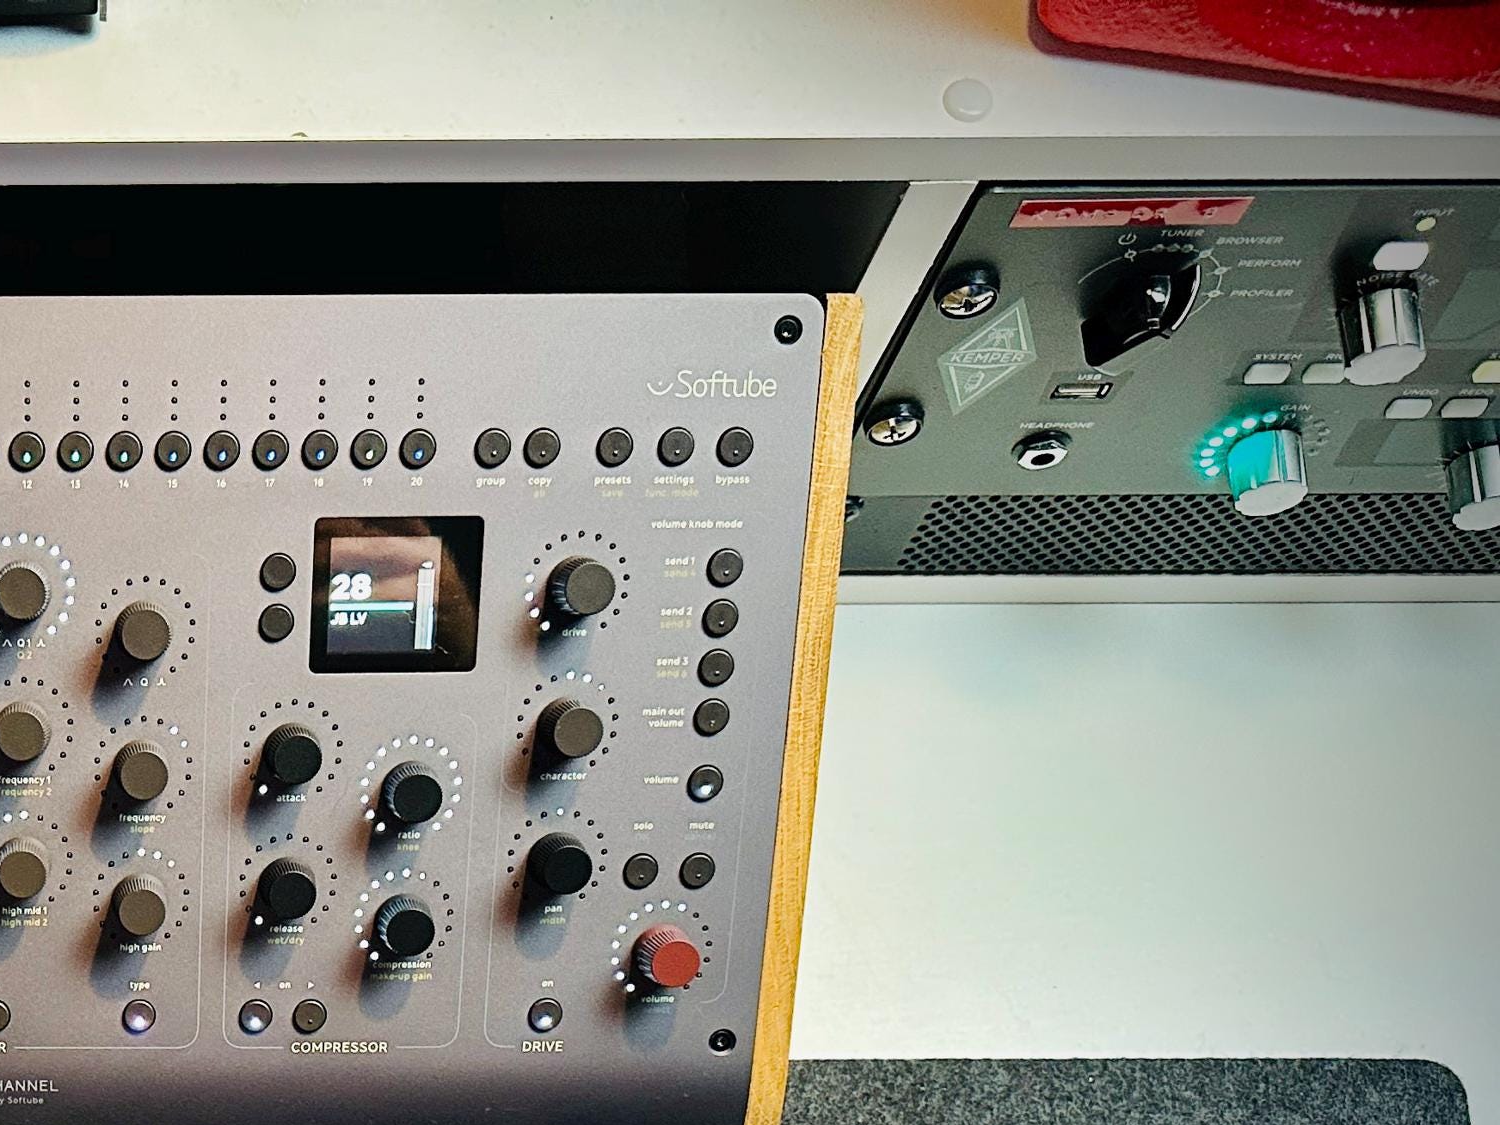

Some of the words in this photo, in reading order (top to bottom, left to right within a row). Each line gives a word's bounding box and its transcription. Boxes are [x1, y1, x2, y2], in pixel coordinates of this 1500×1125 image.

[1160, 230, 1206, 238] TUNER
[1216, 236, 1284, 245] BROWSER
[1237, 259, 1301, 268] PERFORM
[1356, 271, 1404, 287] NOISE
[1229, 289, 1294, 297] PROFILER
[950, 352, 1025, 363] KEMPER
[1252, 353, 1303, 361] SYSTEM
[1077, 373, 1102, 381] USB
[674, 370, 777, 399] Softube
[1403, 388, 1439, 396] UNDO
[1459, 388, 1494, 396] REDO
[1280, 404, 1312, 412] GAIN
[22, 480, 33, 489] 12
[119, 479, 129, 488] 14
[411, 476, 423, 487] 20
[476, 476, 506, 489] group
[528, 475, 552, 488] copy
[594, 474, 632, 486] presets
[653, 474, 694, 486] settings
[715, 474, 750, 486] bypass
[651, 519, 687, 529] volume
[688, 519, 714, 529] knob
[715, 519, 743, 529] mode
[329, 572, 373, 601] 28
[562, 628, 588, 637] drive
[540, 772, 588, 781] character
[276, 793, 307, 803] attack
[269, 924, 304, 933] release
[267, 935, 305, 946] wet/dry
[119, 943, 140, 953] high
[141, 944, 162, 954] gain
[372, 960, 432, 971] compression
[370, 971, 409, 982] make-up
[411, 972, 432, 982] gain
[291, 1041, 388, 1054] COMPRESSOR
[522, 1041, 564, 1053] DRIVE
[7, 1096, 44, 1105] Softube
